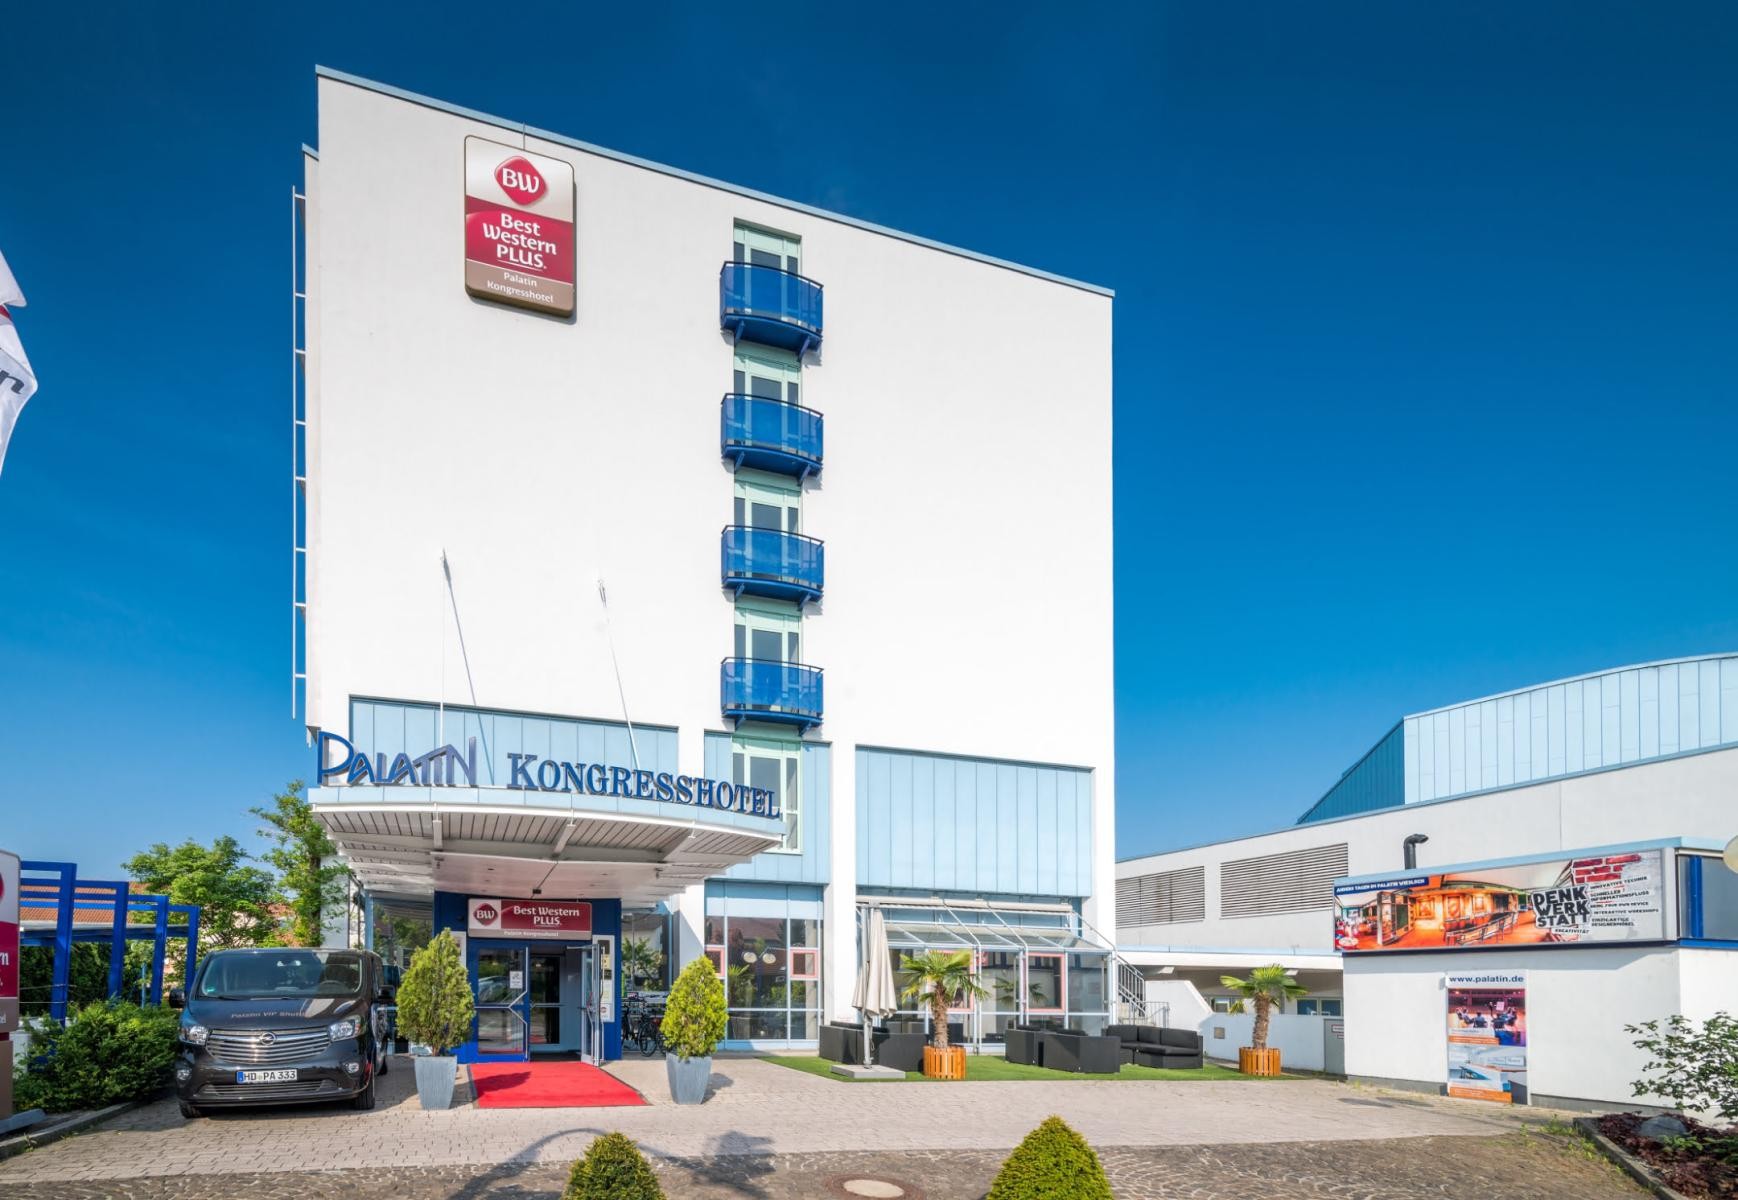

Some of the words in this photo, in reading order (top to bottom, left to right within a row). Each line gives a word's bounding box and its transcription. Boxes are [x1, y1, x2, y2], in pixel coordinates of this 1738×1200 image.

[502, 167, 540, 194] BW
[500, 212, 541, 237] Best
[482, 222, 557, 255] Western
[496, 243, 545, 269] PLUS
[503, 271, 538, 287] Palatin
[486, 280, 554, 304] Kongresshotel
[316, 730, 478, 787] PALATIN
[506, 752, 781, 820] KONGRESSHOTEL
[1533, 886, 1587, 905] DENK
[1590, 889, 1621, 897] SCHNELLER
[1590, 890, 1649, 901] INFORMATIONSFLUSS
[476, 910, 495, 919] BW
[513, 905, 538, 915] Best
[538, 906, 580, 917] Western
[1535, 899, 1590, 916] WERK
[533, 916, 561, 926] PLUS
[1537, 912, 1588, 928] STATT
[1449, 975, 1524, 983] www.palatin.de
[244, 1072, 257, 1081] HD
[263, 1071, 276, 1080] PA
[277, 1070, 296, 1080] 333
